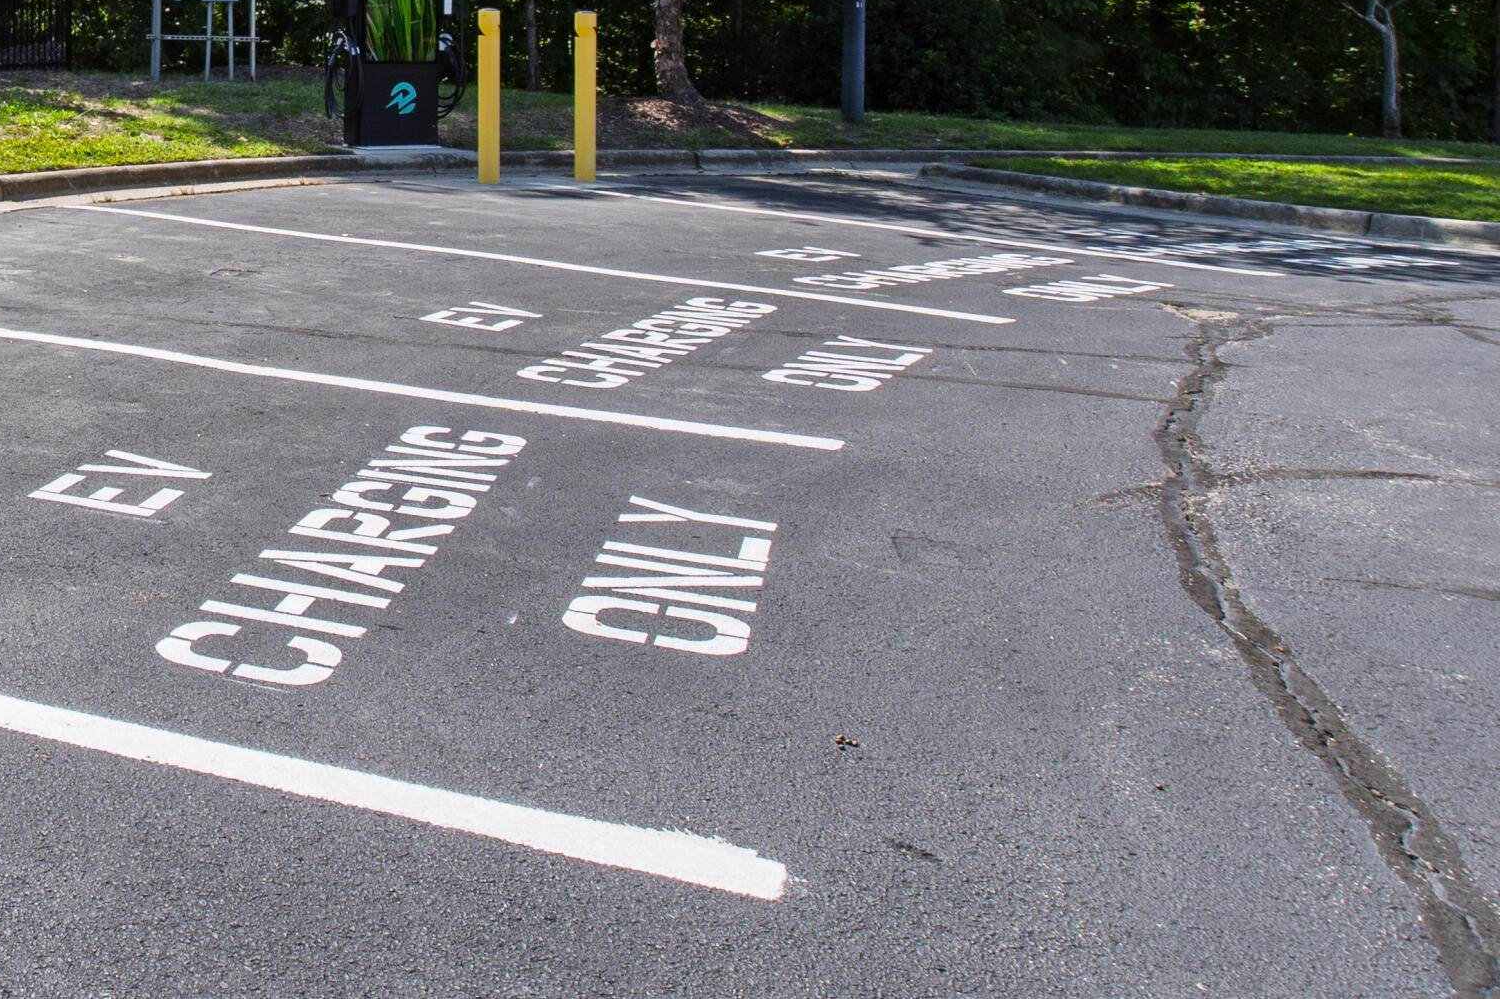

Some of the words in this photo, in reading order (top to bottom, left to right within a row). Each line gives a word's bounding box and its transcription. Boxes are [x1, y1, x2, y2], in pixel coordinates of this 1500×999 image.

[754, 246, 862, 262] EV
[792, 253, 1076, 290] CHARGING
[1002, 273, 1175, 302] ONLY
[419, 301, 544, 332] EV
[516, 297, 779, 389] CHARGING
[761, 335, 934, 392] ONLY
[28, 449, 213, 518] EV
[155, 425, 527, 687] CHARGING
[562, 496, 778, 656] ONLY
